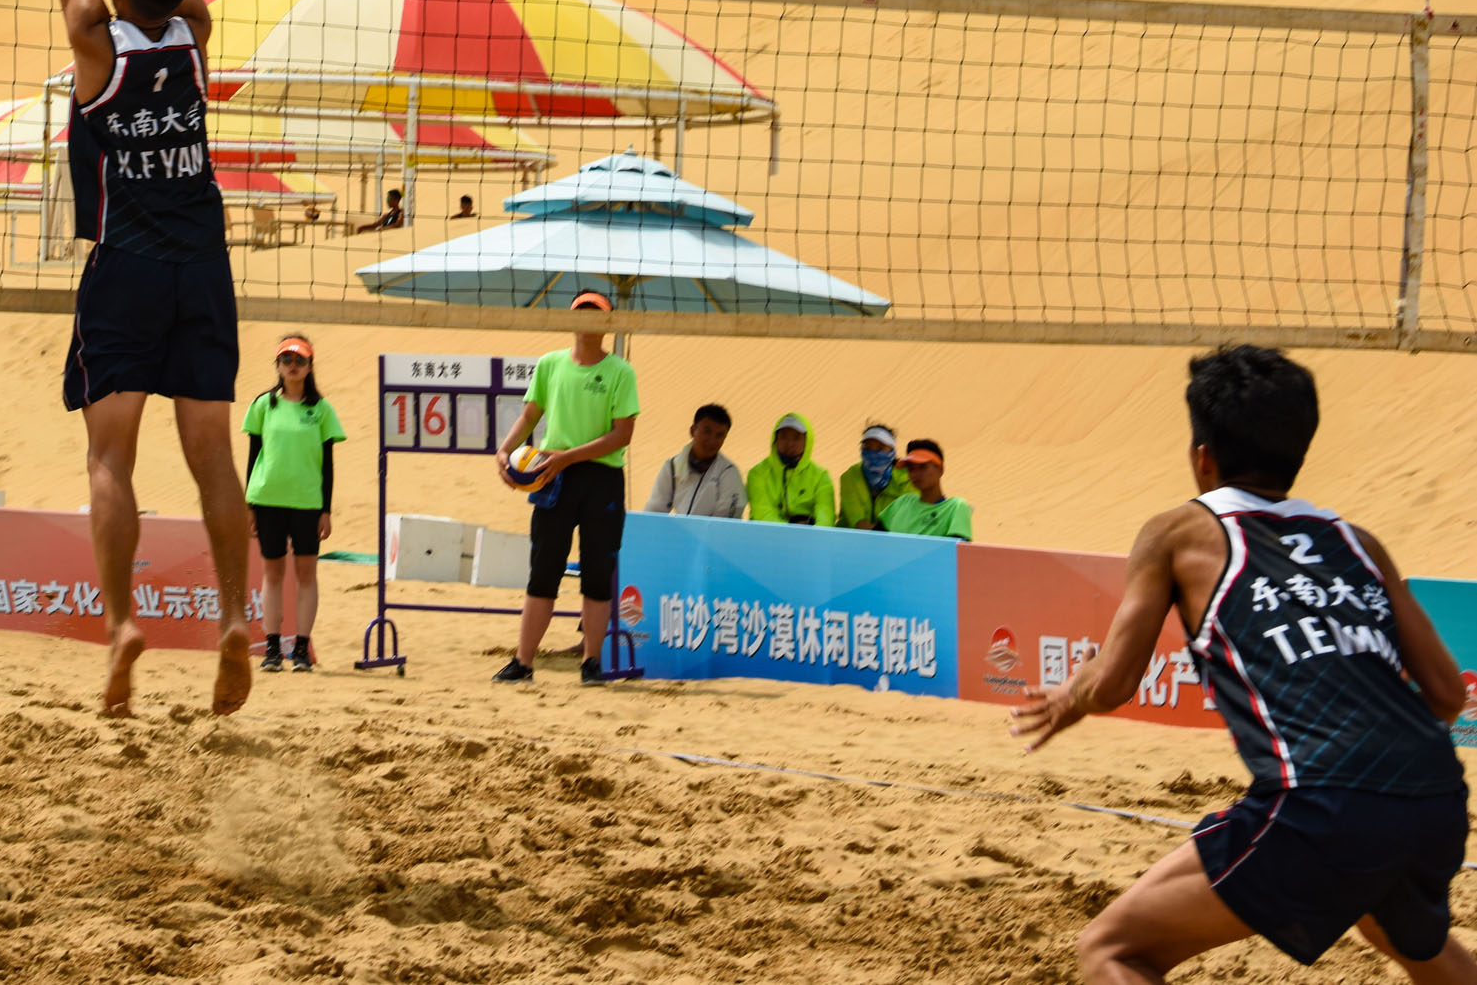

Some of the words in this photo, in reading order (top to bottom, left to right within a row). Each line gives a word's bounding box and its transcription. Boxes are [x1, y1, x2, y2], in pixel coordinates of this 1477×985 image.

[152, 67, 169, 93] 1
[106, 100, 203, 138] 东南大学
[411, 360, 462, 380] 东南大学
[1278, 532, 1324, 565] 2
[1250, 573, 1392, 622] 东南大学
[659, 591, 938, 679] 响沙湾沙漠休闲度假地
